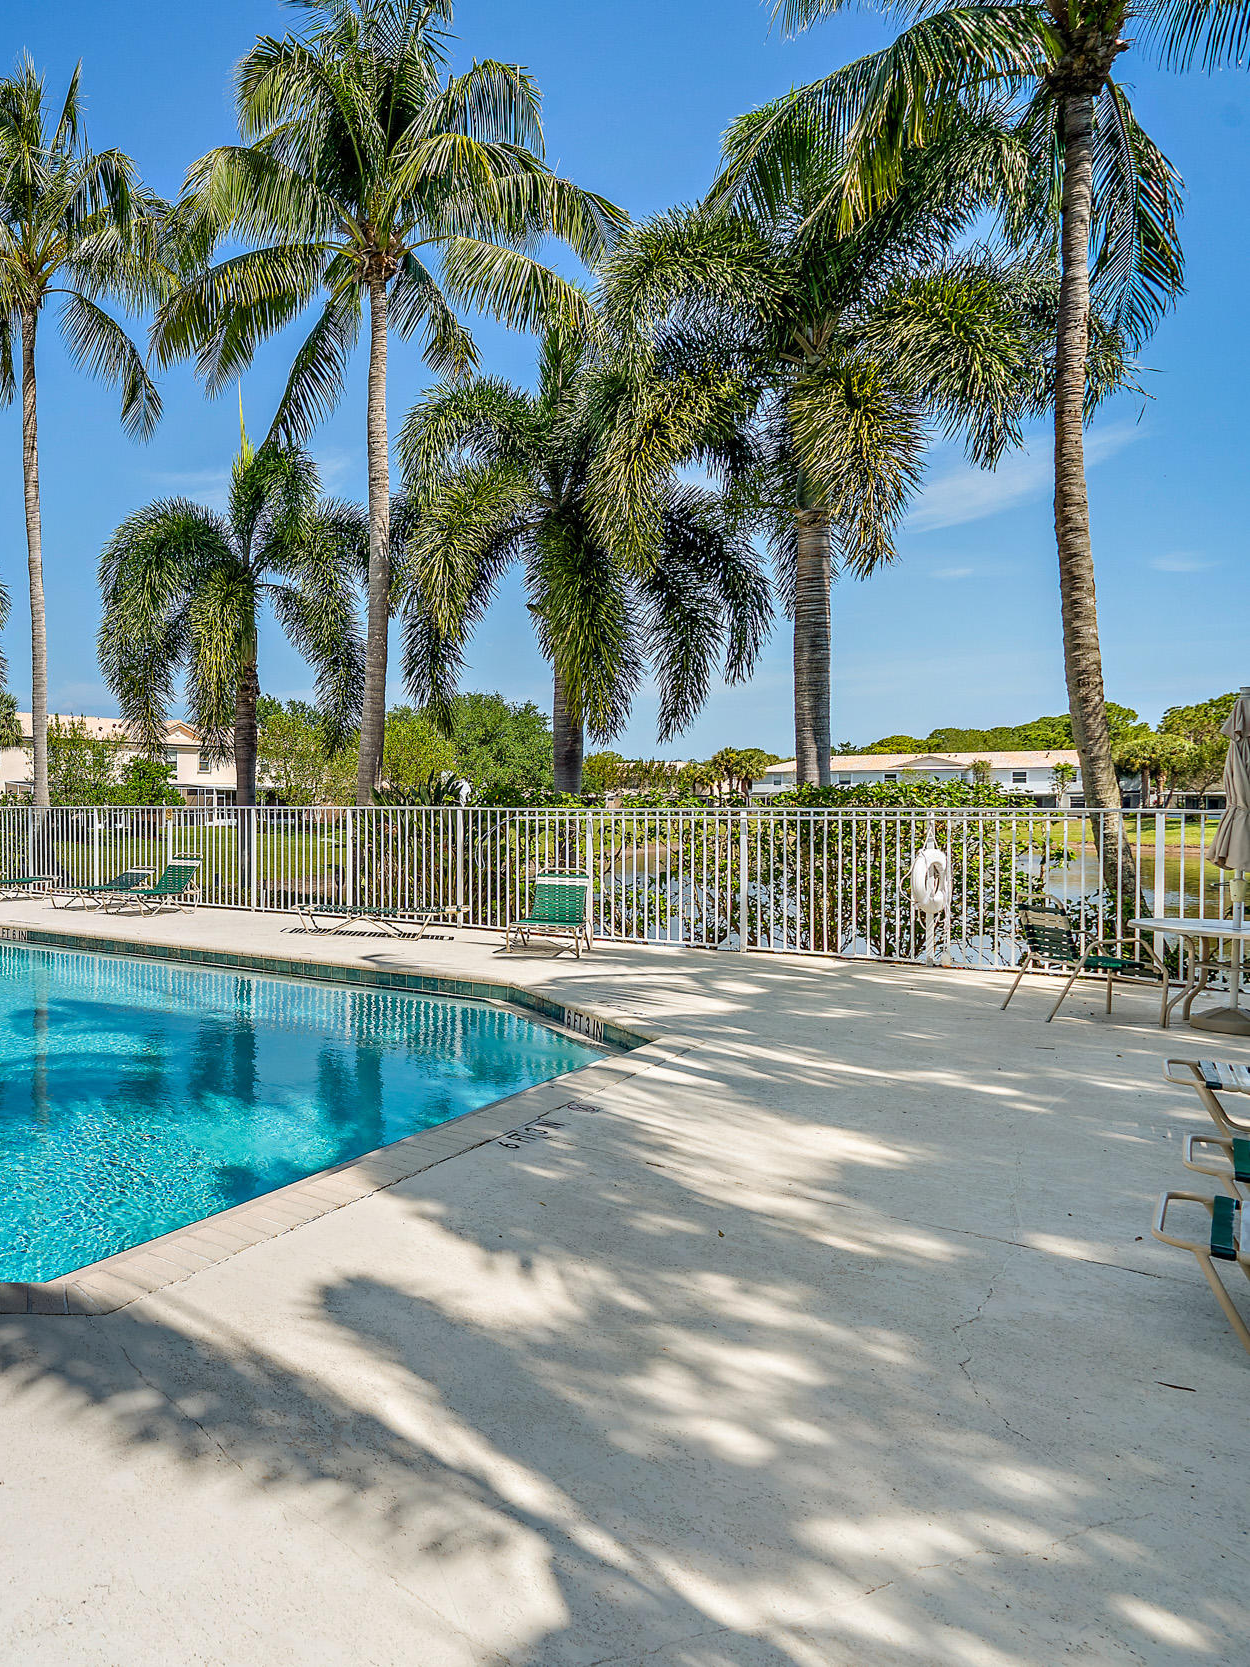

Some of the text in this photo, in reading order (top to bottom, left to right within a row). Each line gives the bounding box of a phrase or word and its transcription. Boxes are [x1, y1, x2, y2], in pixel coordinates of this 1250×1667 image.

[2, 928, 10, 939] FT
[19, 930, 27, 942] IN
[566, 1009, 603, 1043] 6 FT 3 IN
[506, 1133, 538, 1144] FT
[498, 1141, 520, 1149] 6
